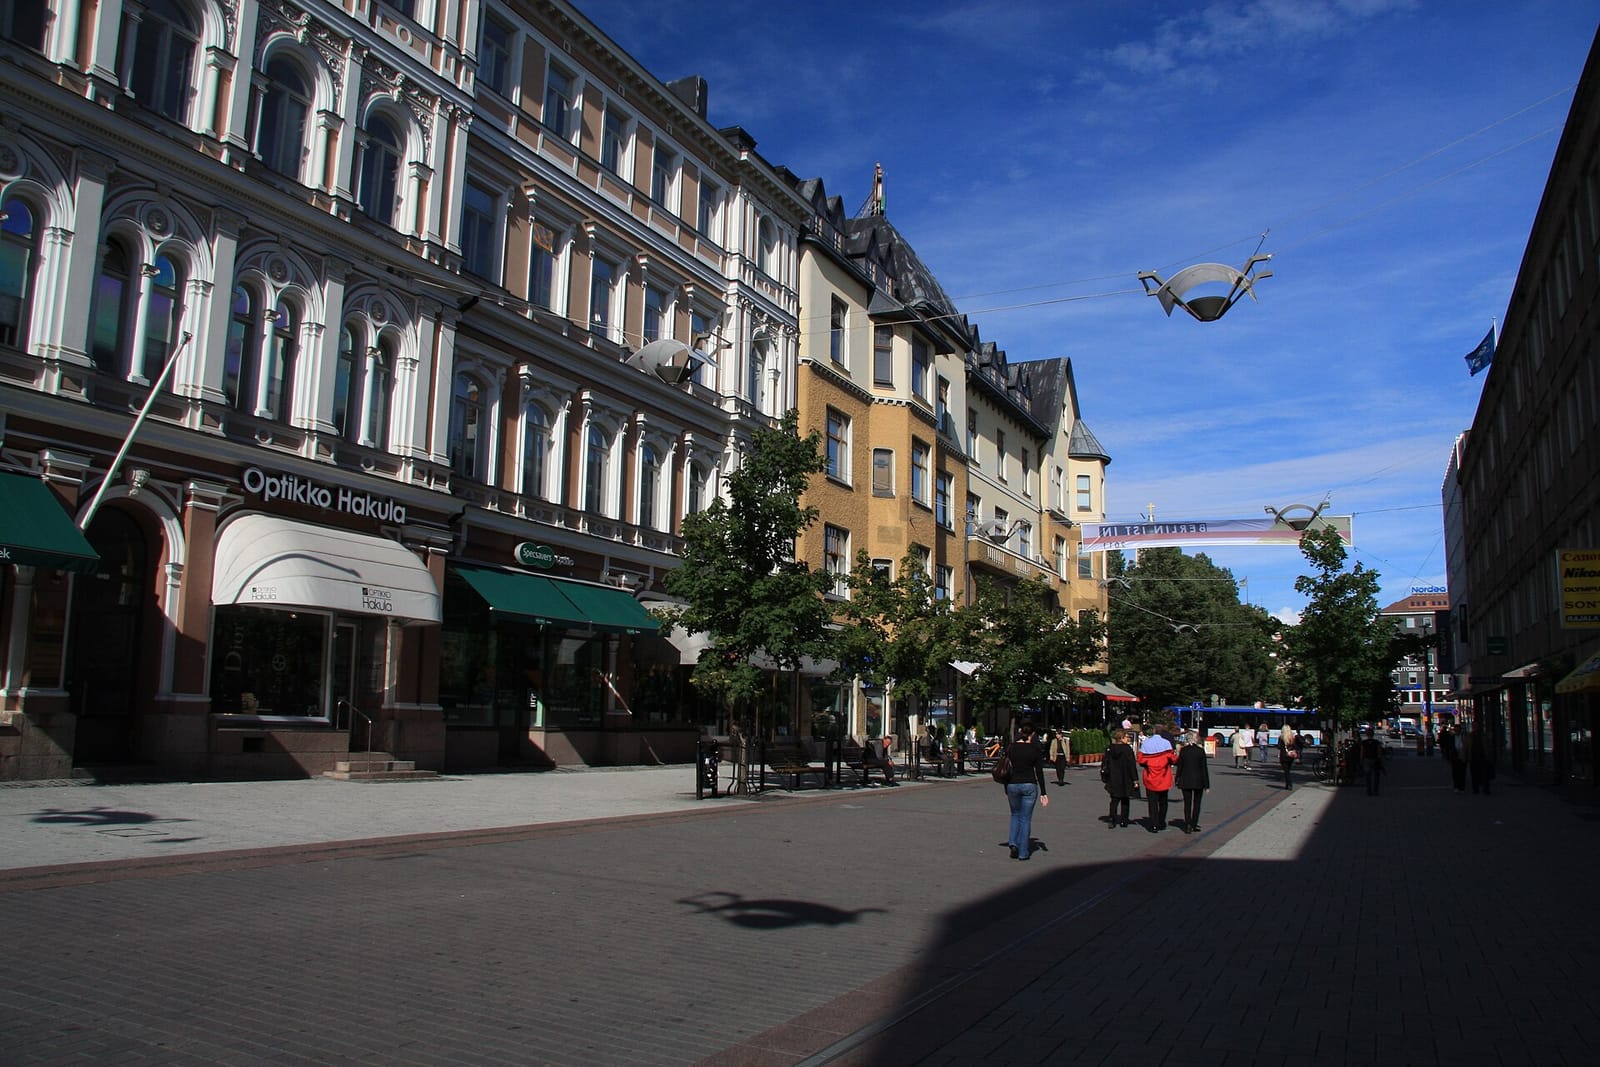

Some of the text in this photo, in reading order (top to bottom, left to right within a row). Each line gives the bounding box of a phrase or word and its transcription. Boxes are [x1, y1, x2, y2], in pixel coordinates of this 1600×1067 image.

[243, 467, 407, 524] Optikko Hakula
[1411, 585, 1446, 593] Nordea
[363, 596, 393, 612] Hakula
